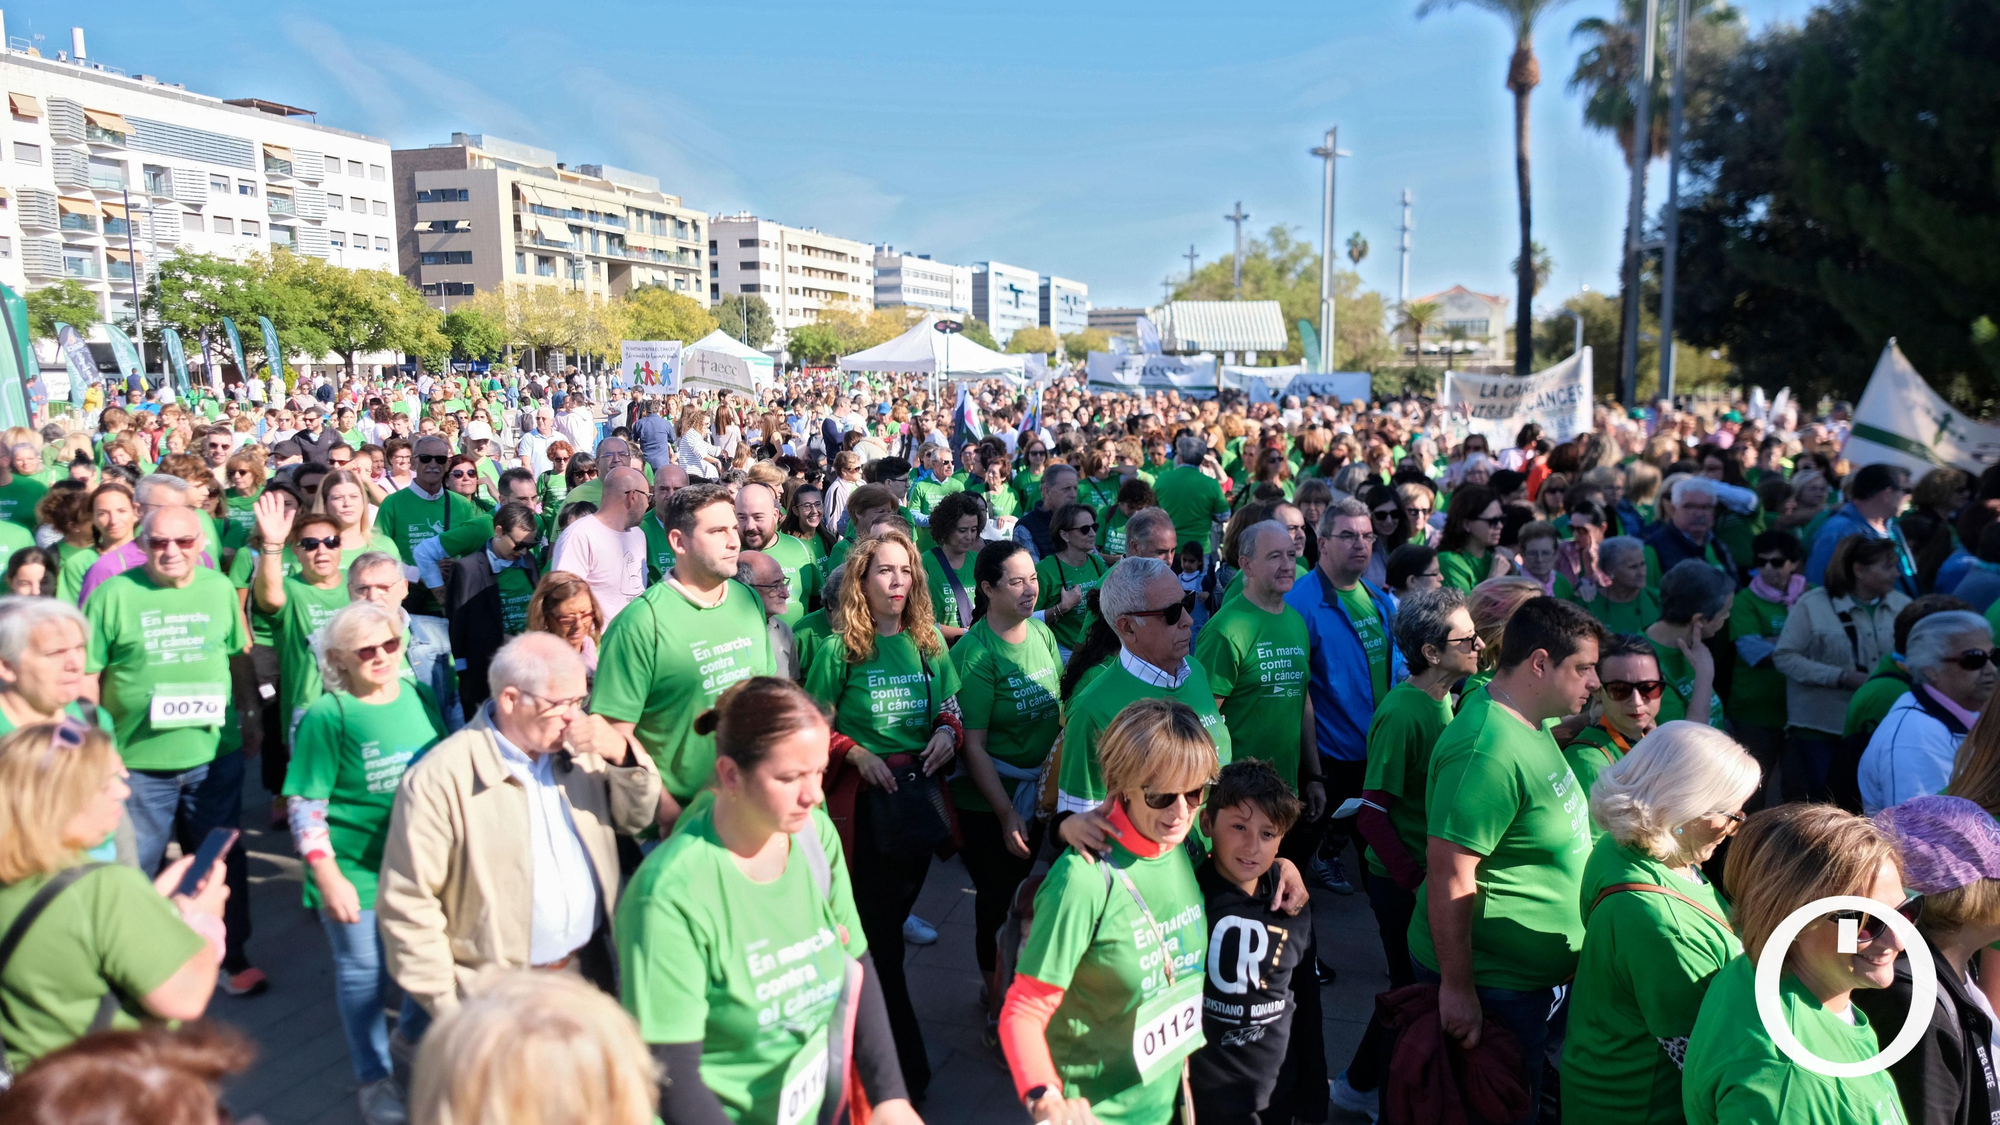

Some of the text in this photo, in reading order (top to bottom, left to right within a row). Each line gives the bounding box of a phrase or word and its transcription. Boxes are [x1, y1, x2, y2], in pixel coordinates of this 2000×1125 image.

[711, 362, 738, 376] aecc
[141, 612, 211, 628] En marcha
[143, 625, 189, 638] contra
[144, 636, 205, 650] el cáncer
[692, 647, 712, 662] En
[712, 637, 753, 656] marcha
[1363, 637, 1383, 650] ncer
[1257, 645, 1305, 659] En marcha
[699, 656, 735, 676] contra
[1260, 658, 1292, 671] contra
[702, 666, 751, 690] el cáncer
[868, 674, 886, 688] En
[1008, 666, 1053, 688] En marcha
[1260, 669, 1304, 683] el cáncer
[870, 686, 912, 700] contra
[1013, 683, 1044, 699] contra
[163, 701, 218, 716] 0070
[871, 698, 928, 713] el cáncer
[1016, 690, 1057, 711] el cáncer
[1552, 781, 1567, 798] En
[747, 953, 777, 978] En
[755, 963, 818, 1002] contra
[1141, 969, 1157, 991] el
[757, 1000, 780, 1027] el
[1250, 999, 1285, 1018] RONALDO
[1143, 1007, 1195, 1056] 0112
[1983, 1066, 1996, 1089] LIFE
